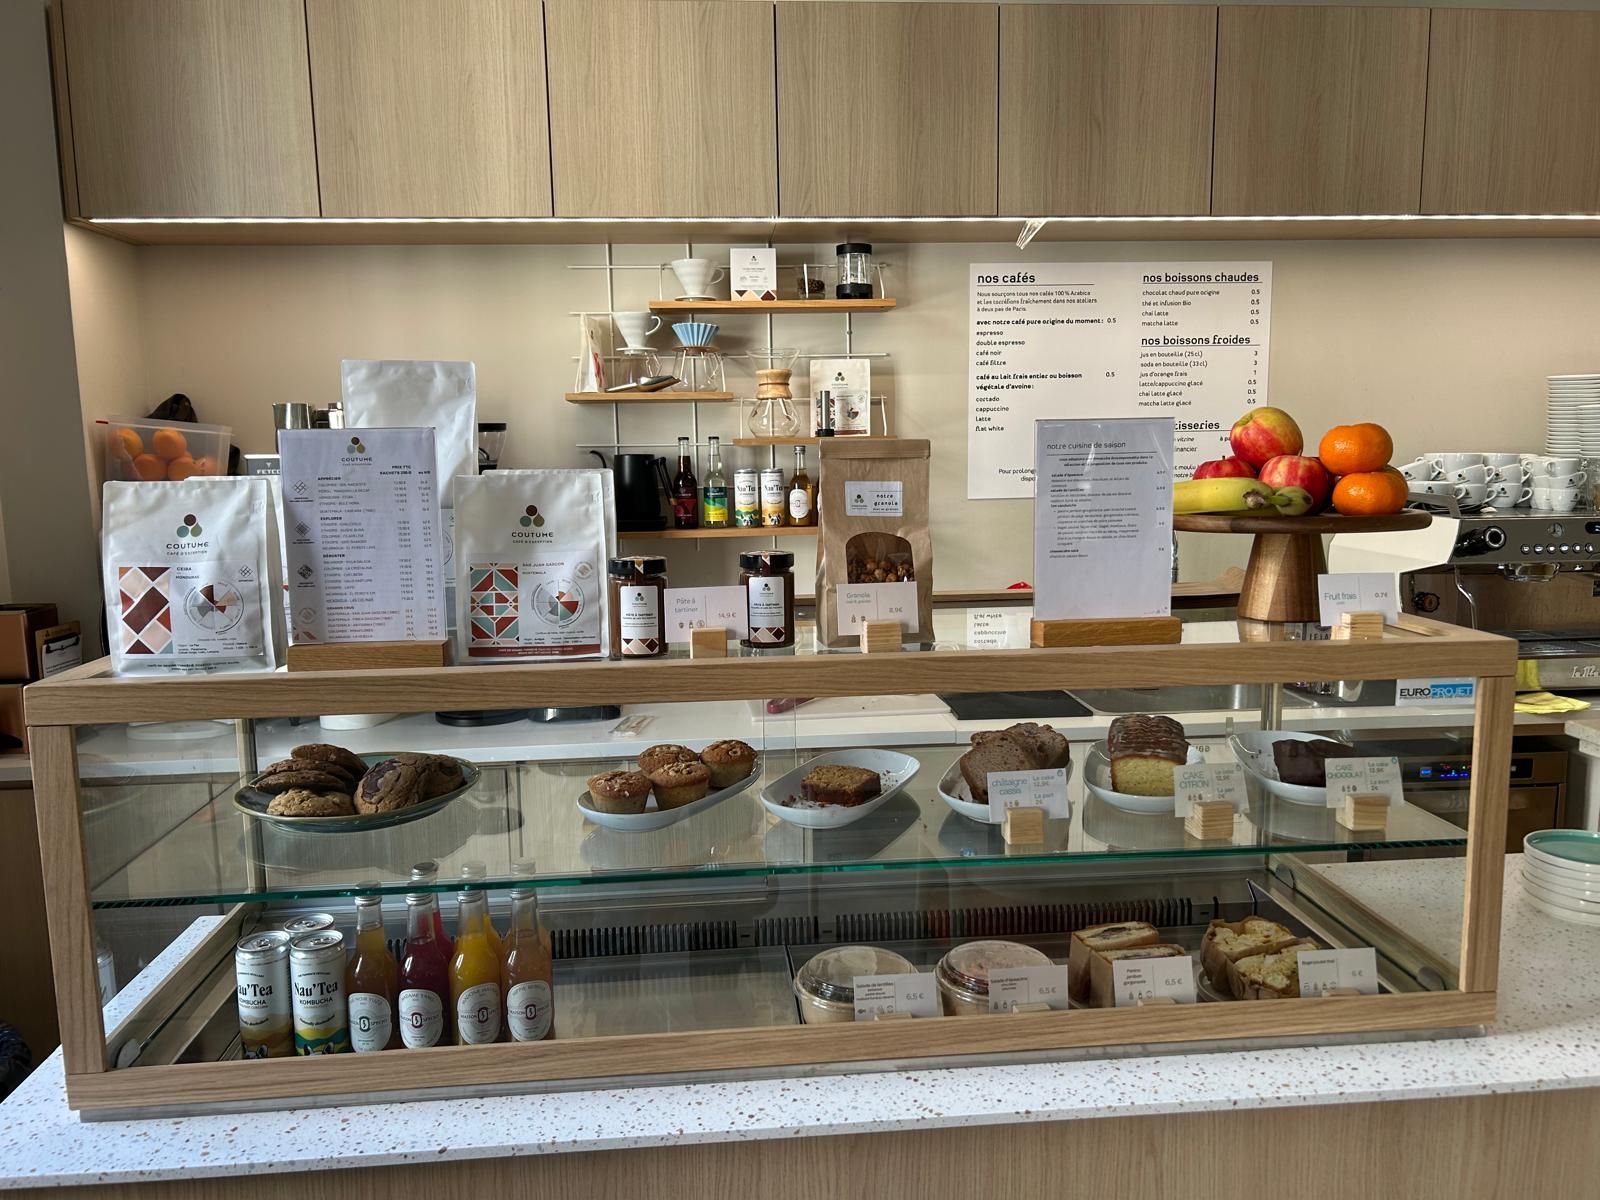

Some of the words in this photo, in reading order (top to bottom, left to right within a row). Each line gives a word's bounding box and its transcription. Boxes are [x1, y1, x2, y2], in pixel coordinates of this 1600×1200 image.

[977, 274, 999, 283] nos
[1002, 272, 1036, 283] cafés
[1143, 274, 1162, 283] nos
[1165, 273, 1212, 283] boissons
[1215, 272, 1259, 282] chaudes
[1141, 337, 1160, 345] nos
[1163, 336, 1210, 345] boissons
[1212, 335, 1251, 345] froides
[166, 541, 209, 550] COUTUME
[1324, 592, 1340, 600] Fruit
[1341, 592, 1357, 600] frais
[676, 597, 691, 605] Pâte
[1400, 687, 1473, 697] EUROPROJET
[1182, 771, 1204, 779] CAKE
[1327, 771, 1363, 779] CHOCOLAT
[1179, 780, 1209, 789] CITRON
[238, 984, 273, 997] au'Tea
[300, 997, 333, 1006] KOMBUCHA
